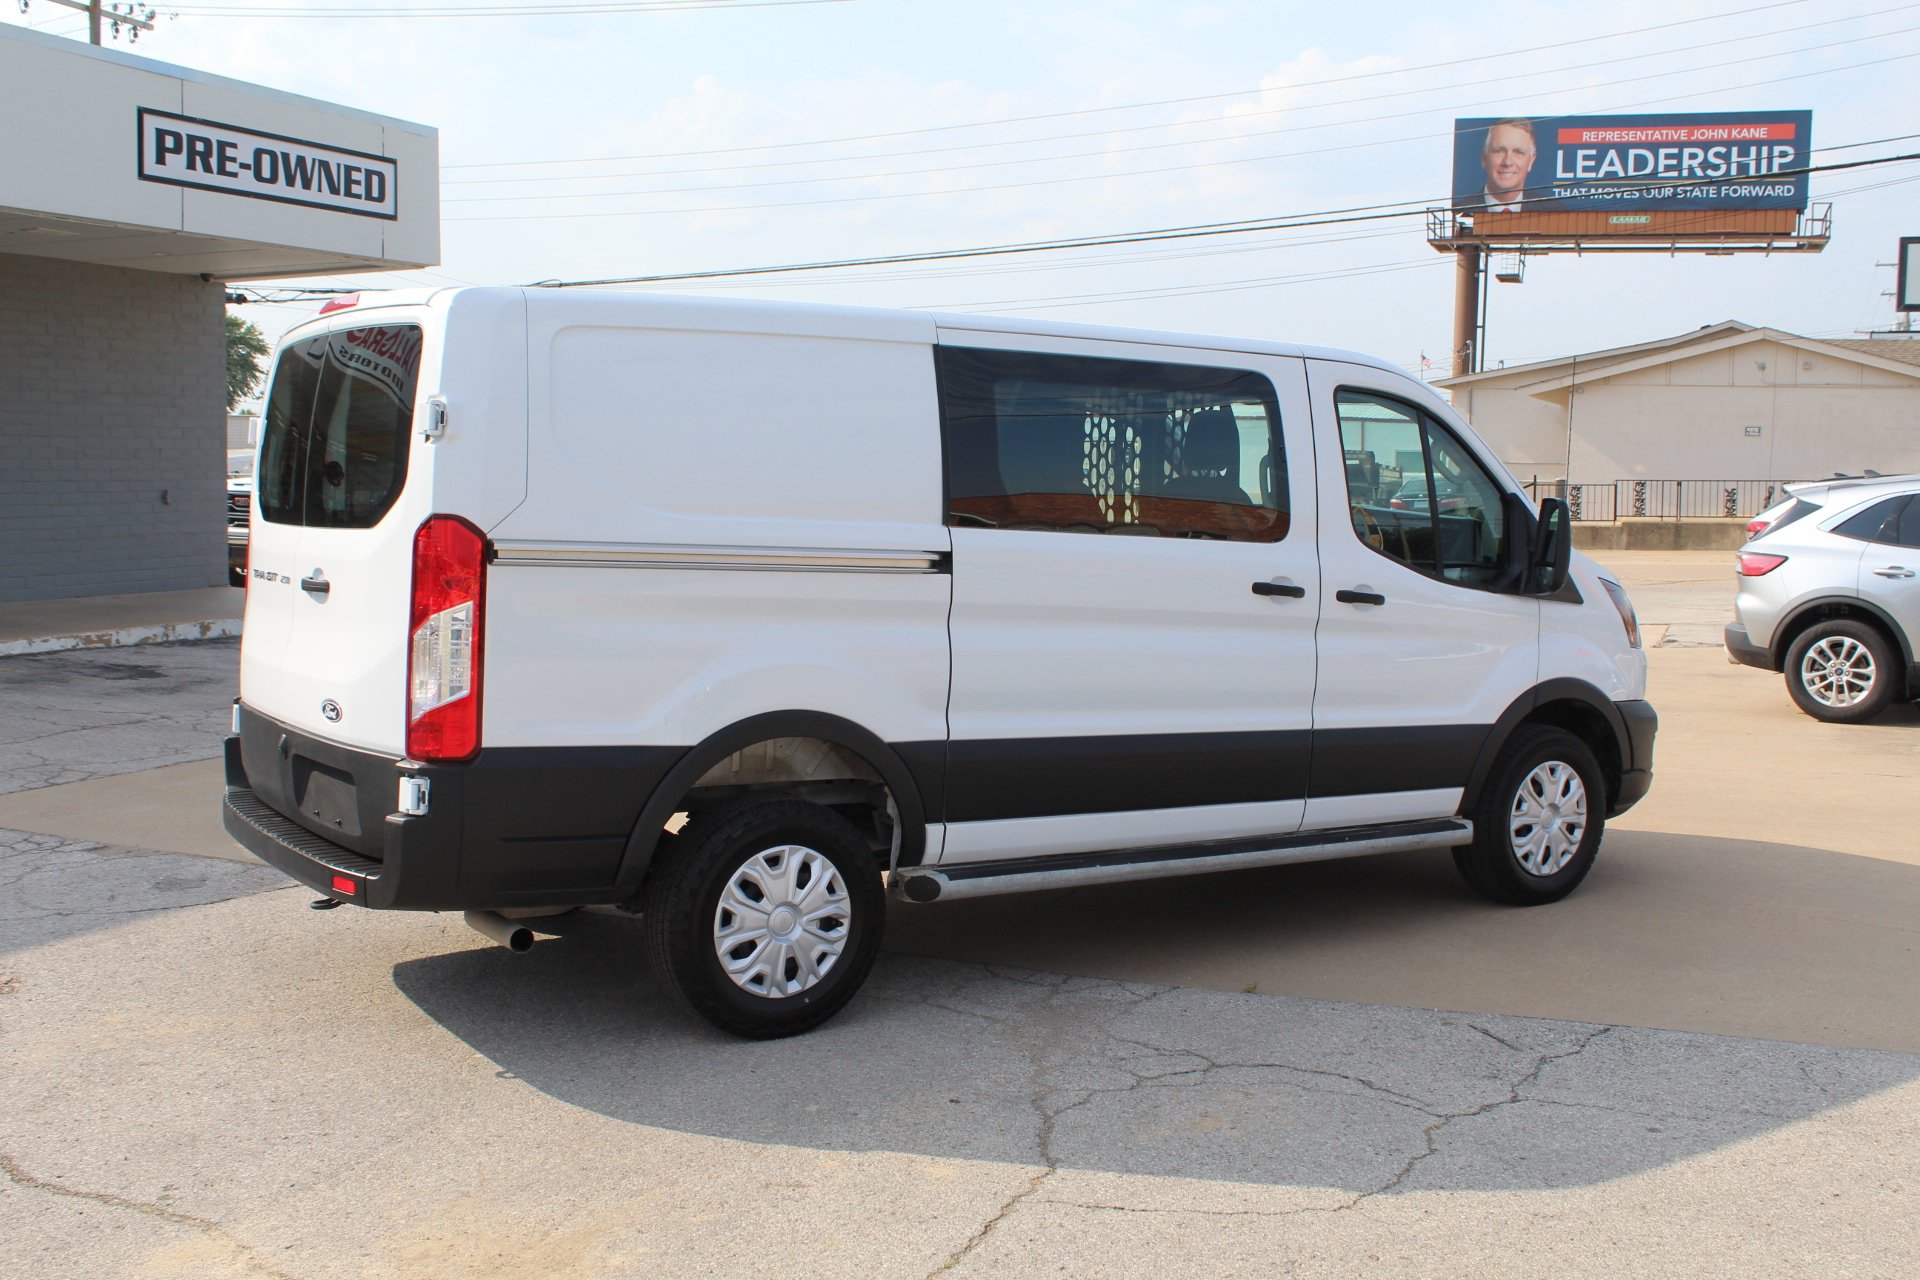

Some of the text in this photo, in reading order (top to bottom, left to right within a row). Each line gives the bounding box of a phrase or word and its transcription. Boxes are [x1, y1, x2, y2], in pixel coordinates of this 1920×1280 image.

[1582, 127, 1768, 142] REPRESENTATIVE JOHN KANE
[154, 126, 386, 204] PRE-OWNED
[1556, 145, 1796, 179] LEADERSHIP
[1553, 188, 1588, 200] THAT
[1677, 186, 1717, 198] STATE
[1721, 185, 1795, 198] FORWARD
